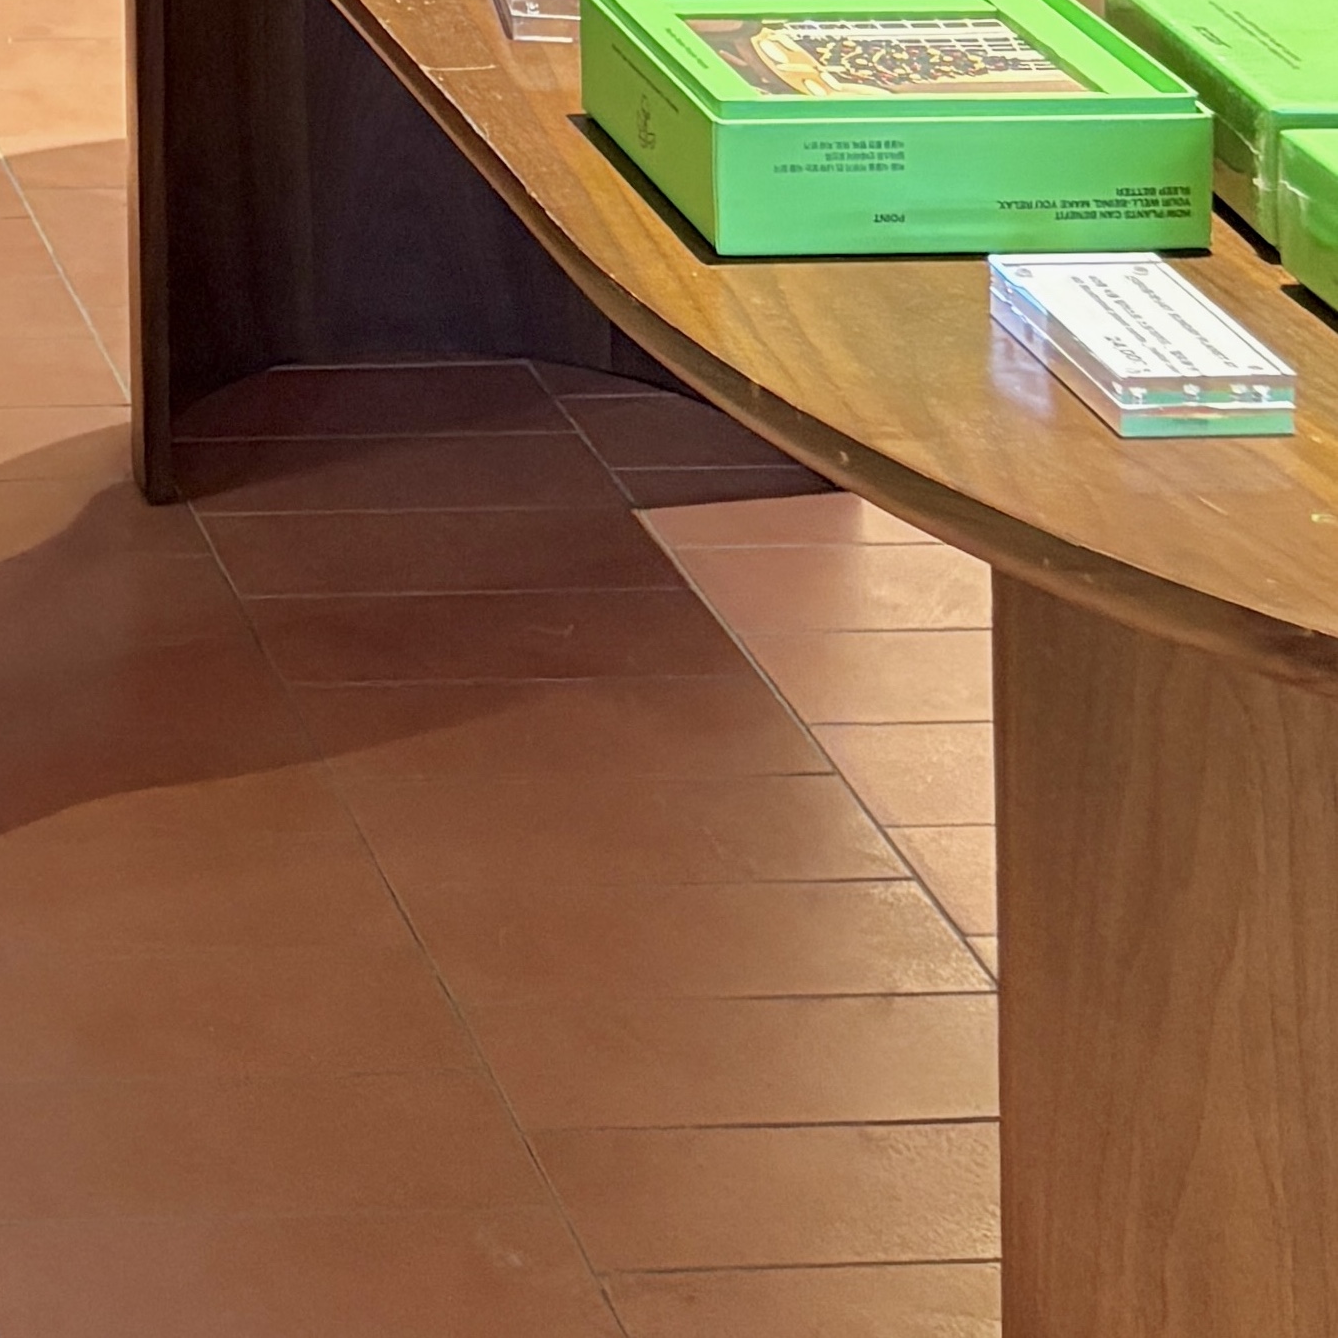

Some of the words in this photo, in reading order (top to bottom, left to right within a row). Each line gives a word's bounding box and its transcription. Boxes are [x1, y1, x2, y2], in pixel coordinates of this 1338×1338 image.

[1115, 187, 1156, 197] BETTER
[1158, 186, 1191, 196] SLEEP
[1035, 200, 1057, 210] YOU
[1060, 199, 1090, 209] MAKE
[1161, 197, 1191, 207] YOUR
[873, 213, 906, 224] POINT
[1055, 210, 1097, 221] BENEFIT
[1099, 210, 1122, 220] CAN
[1124, 209, 1164, 219] PLANTS
[1167, 209, 1191, 218] HOW
